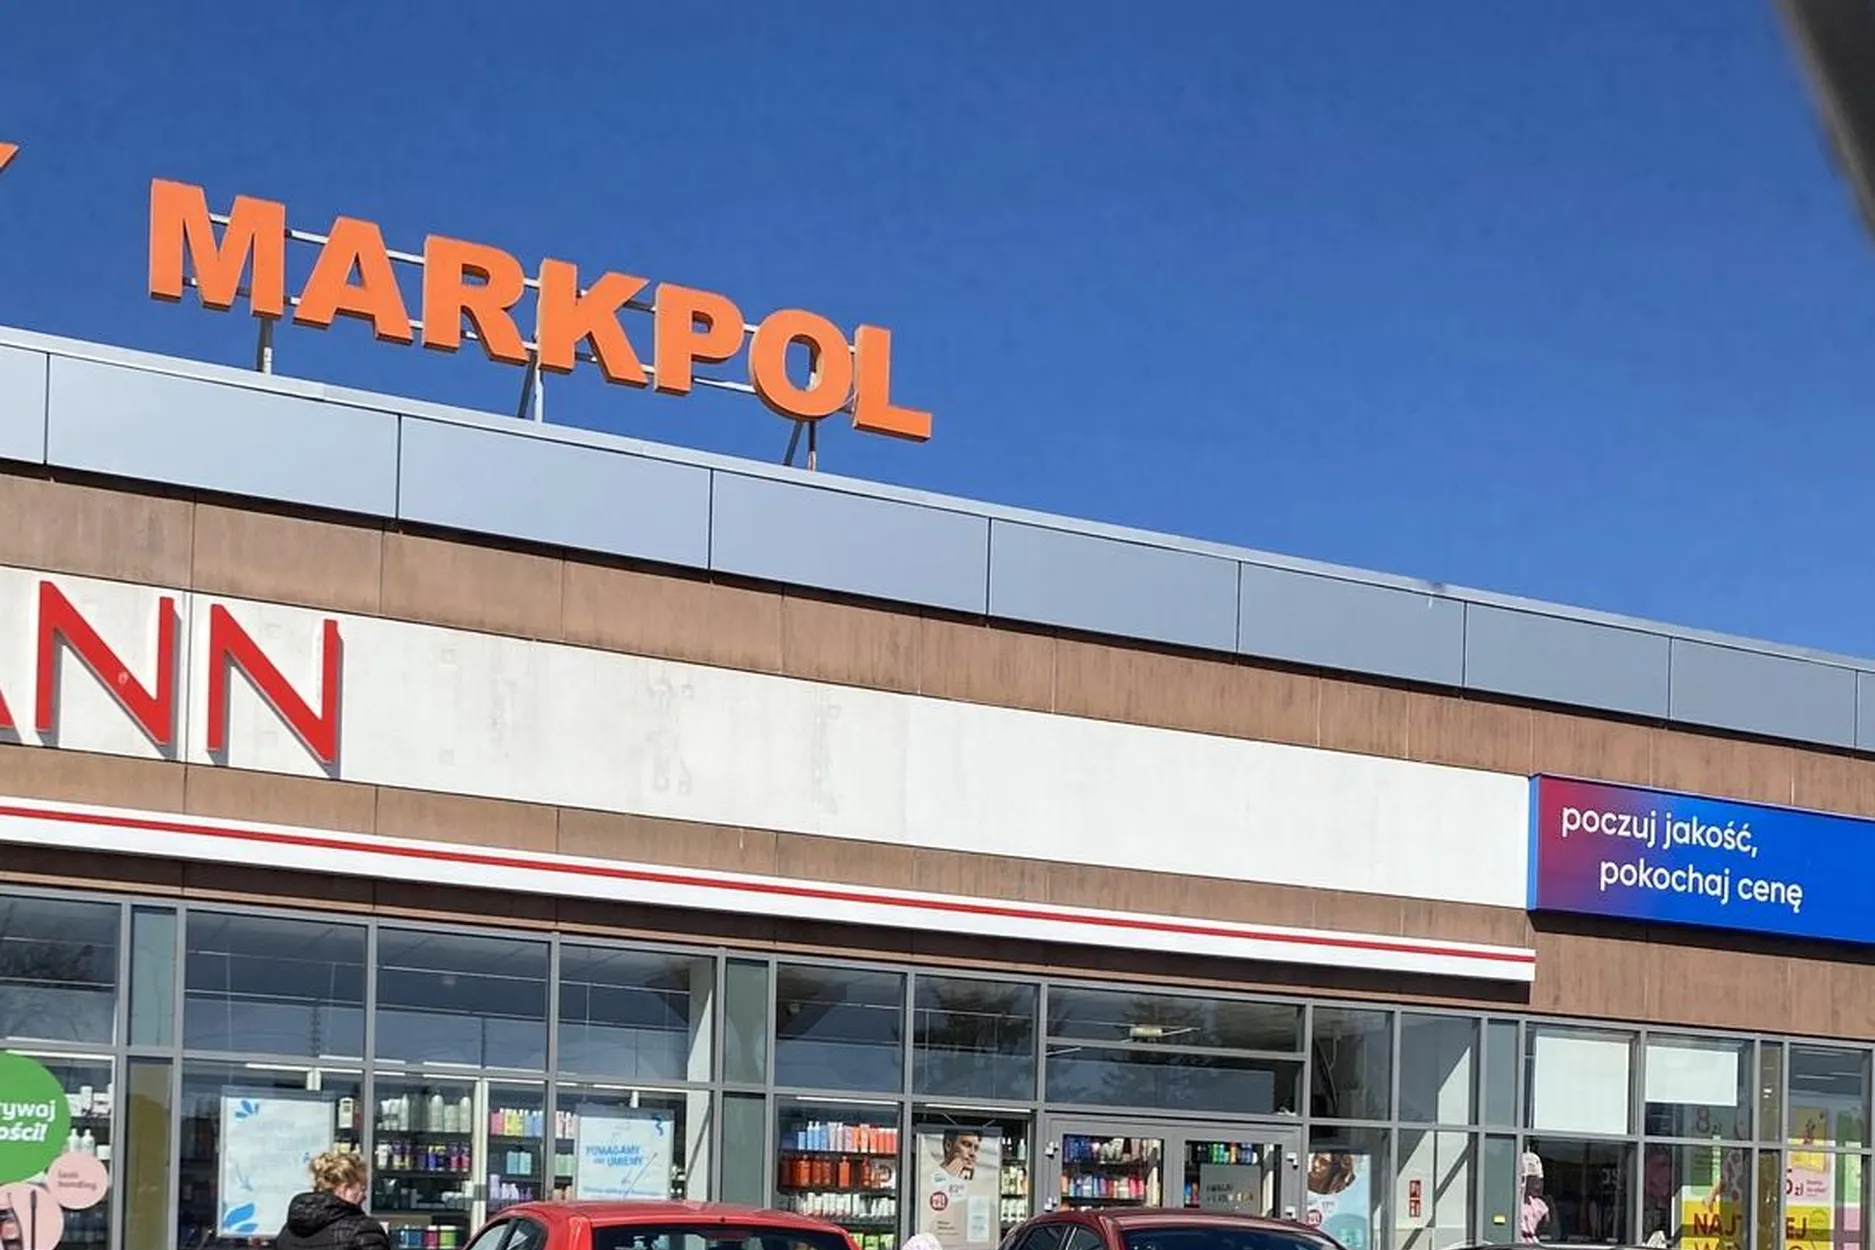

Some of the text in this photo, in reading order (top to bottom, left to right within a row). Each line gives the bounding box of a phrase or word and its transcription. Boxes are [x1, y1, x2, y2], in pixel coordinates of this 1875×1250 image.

[150, 178, 934, 441] MARKPOL
[0, 580, 338, 766] NN
[1561, 805, 1759, 859] poczuj jakość,
[1599, 858, 1803, 914] pokochaj cenę
[0, 1100, 56, 1122] ywaj
[1693, 1212, 1742, 1237] NAJ
